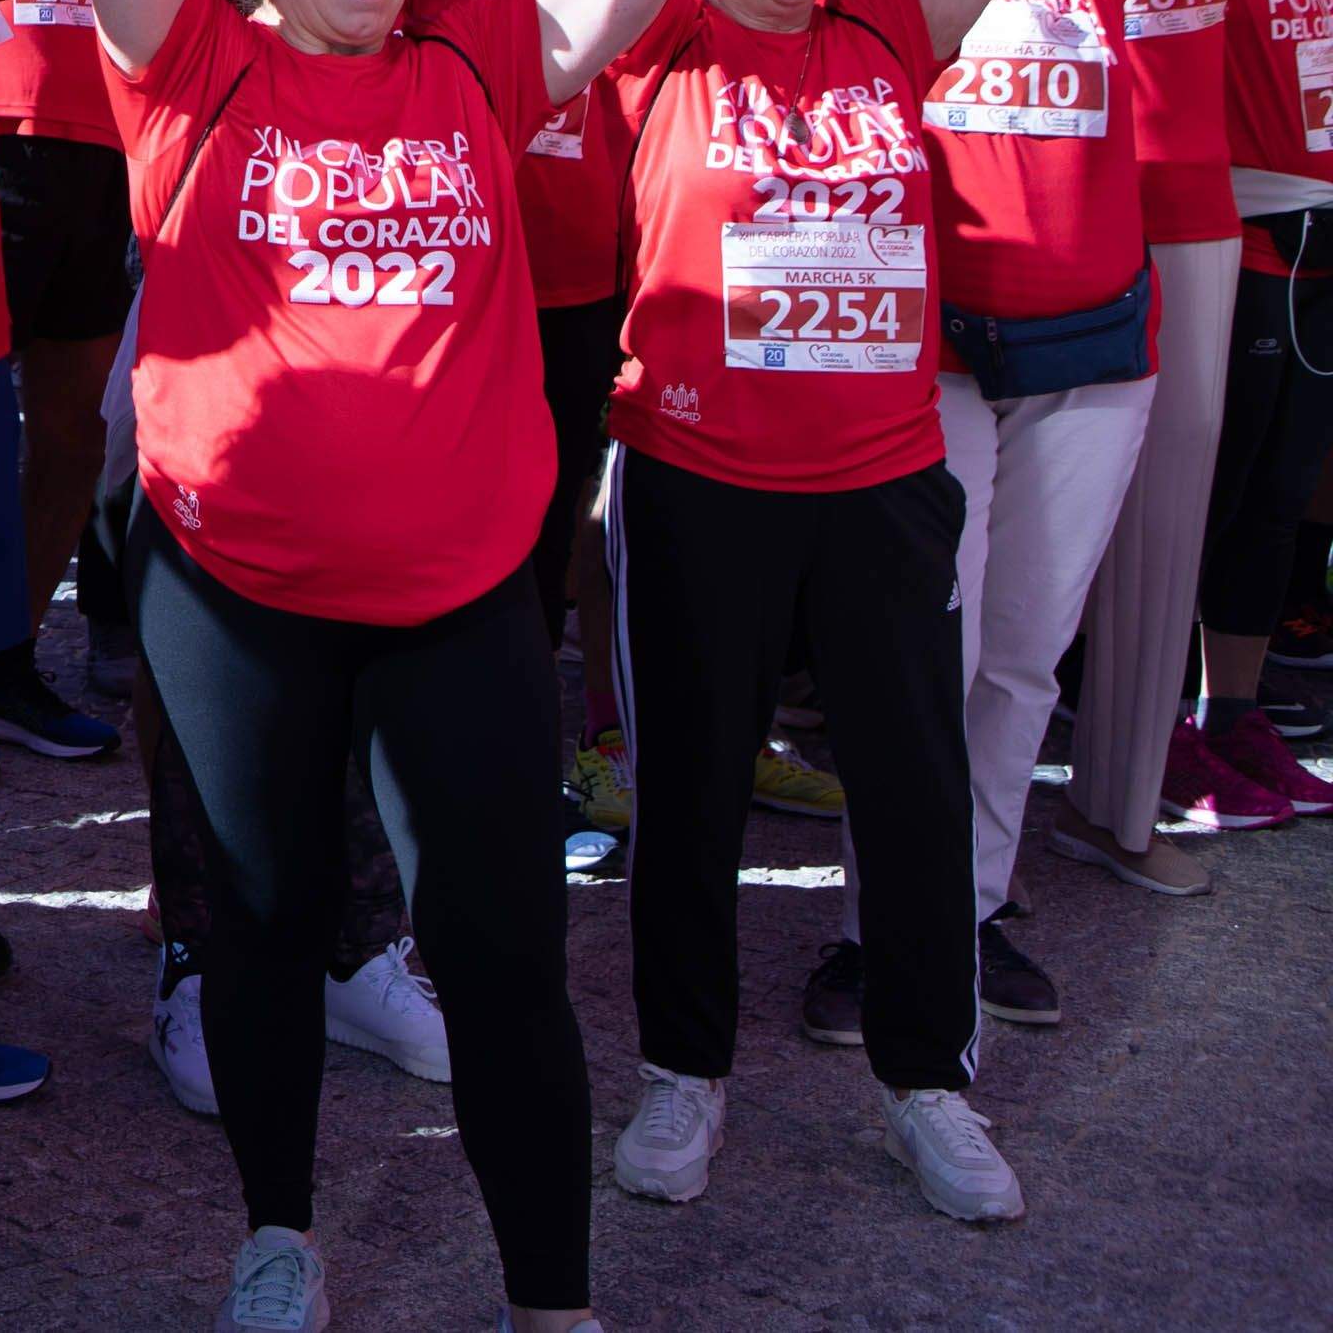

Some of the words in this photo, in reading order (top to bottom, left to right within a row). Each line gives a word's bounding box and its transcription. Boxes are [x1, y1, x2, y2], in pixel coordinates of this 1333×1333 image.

[1271, 18, 1313, 41] DEL
[1039, 45, 1057, 57] 5K
[944, 59, 1080, 107] 2810
[251, 126, 304, 161] XIII
[316, 131, 470, 178] CARRERA
[706, 141, 774, 174] DEL
[241, 158, 484, 211] POPULAR
[753, 177, 905, 224] 2022
[238, 210, 310, 247] DEL
[318, 208, 491, 248] CORAZÓN
[813, 230, 861, 243] POPULAR
[749, 245, 770, 258] DEL
[772, 243, 828, 258] CORAZÓN
[831, 246, 856, 259] 2022
[288, 251, 454, 307] 2022
[785, 271, 854, 284] MARCHA
[858, 272, 877, 284] 5K
[759, 290, 901, 340] 2254
[766, 349, 783, 362] 20
